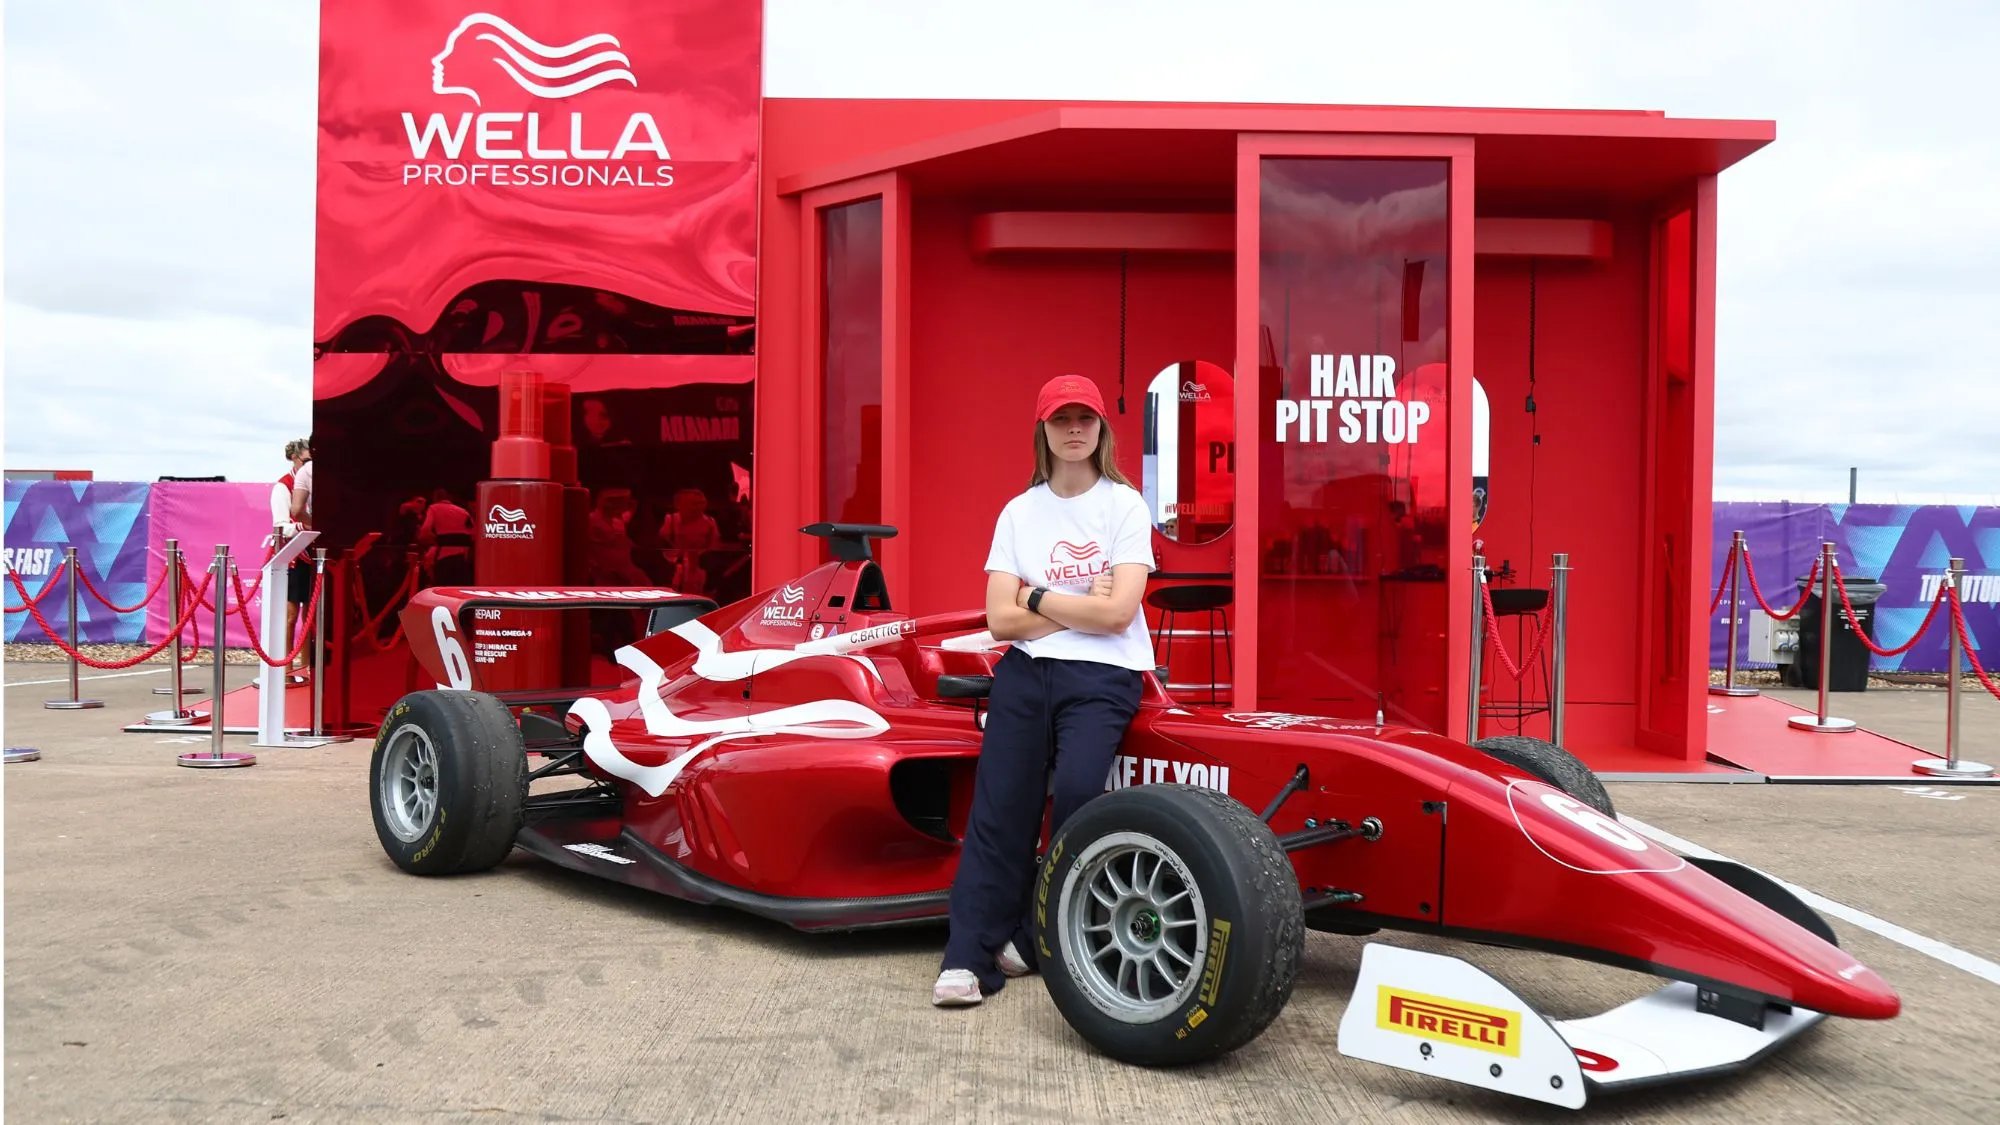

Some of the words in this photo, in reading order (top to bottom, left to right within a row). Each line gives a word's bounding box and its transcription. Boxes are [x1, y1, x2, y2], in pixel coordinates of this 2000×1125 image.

[401, 112, 671, 160] WELLA
[402, 163, 674, 187] PROFESSIONALS
[1310, 354, 1397, 397] HAIR
[1179, 392, 1211, 400] WELLA
[1275, 399, 1333, 442] PIT
[1339, 399, 1430, 443] STOP
[485, 523, 533, 534] WELLA
[15, 548, 54, 576] FAST
[1045, 560, 1111, 581] WELLA
[763, 606, 804, 620] WELLA
[431, 605, 472, 690] 6
[850, 623, 899, 644] C.BATTIG
[1143, 758, 1169, 785] IT
[1540, 793, 1649, 851] 6
[1037, 836, 1064, 929] ZERO
[1198, 918, 1231, 1007] PIRELLI
[1389, 995, 1509, 1047] PIRELLI
